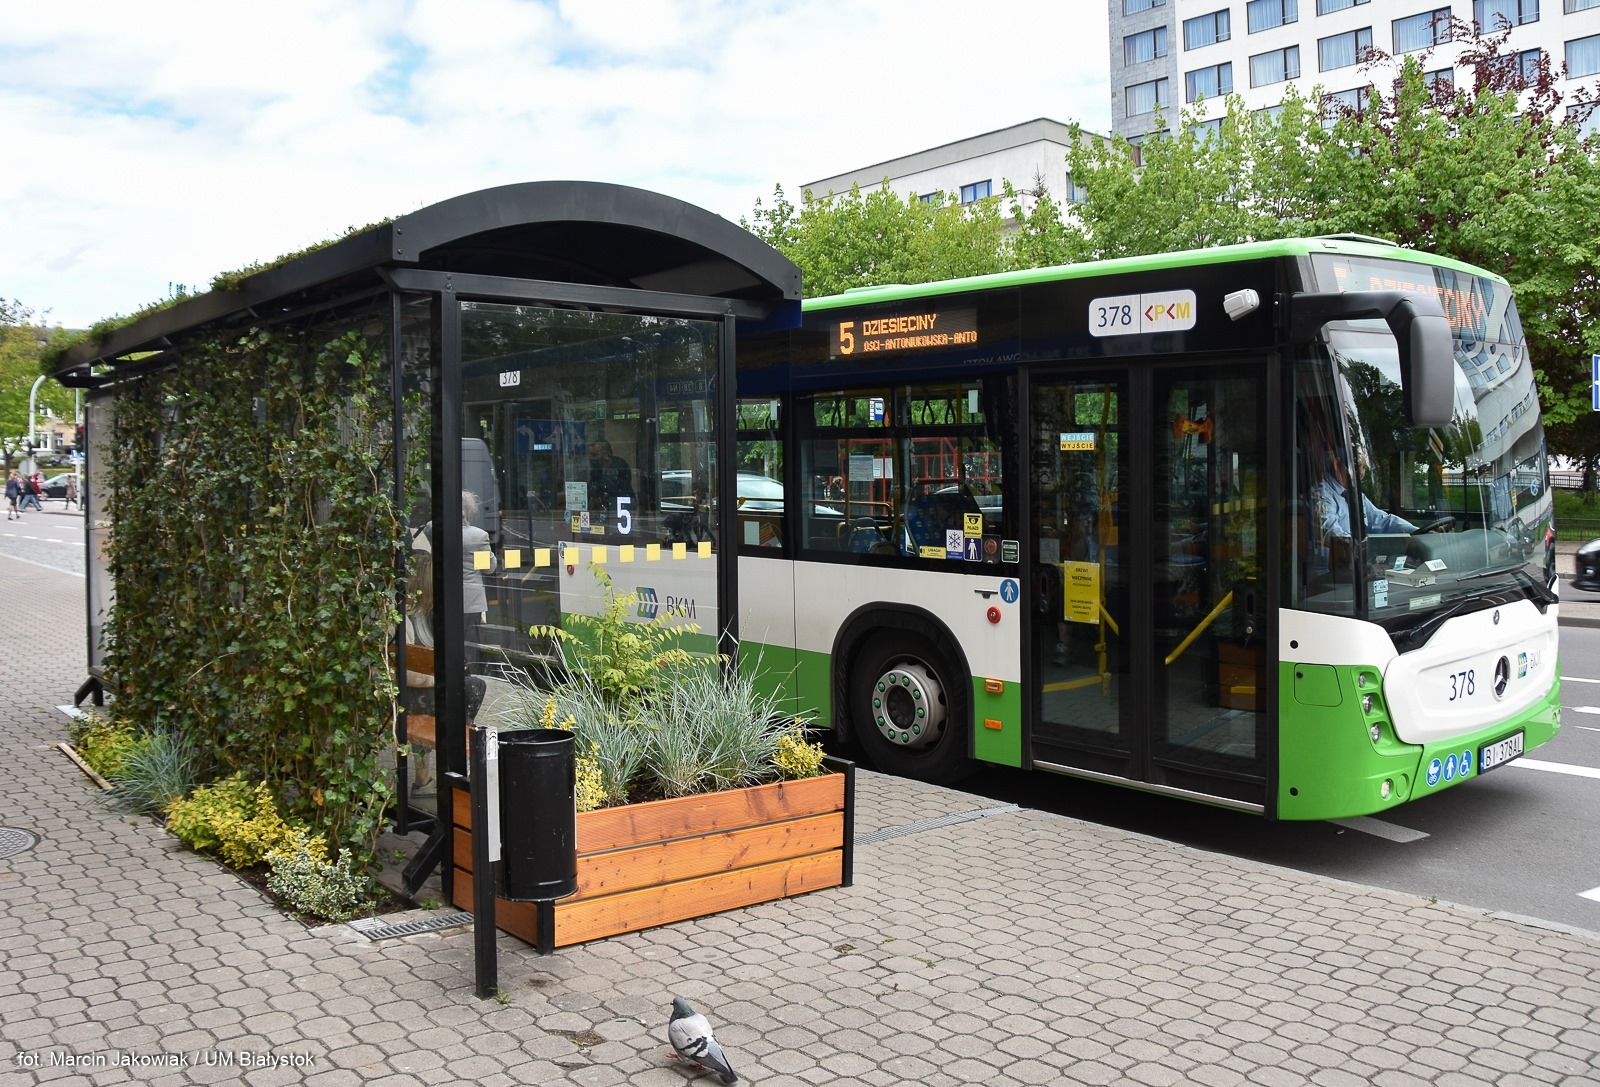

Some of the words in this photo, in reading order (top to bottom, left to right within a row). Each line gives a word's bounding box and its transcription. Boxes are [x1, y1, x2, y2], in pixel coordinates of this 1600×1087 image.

[862, 313, 937, 336] DZIESIĘCINY
[1097, 305, 1132, 328] 378
[839, 321, 855, 355] 5
[616, 496, 632, 535] 5
[666, 595, 697, 620] BKM
[1449, 669, 1475, 702] 378
[1485, 747, 1497, 767] BI
[1499, 739, 1523, 761] 378AL
